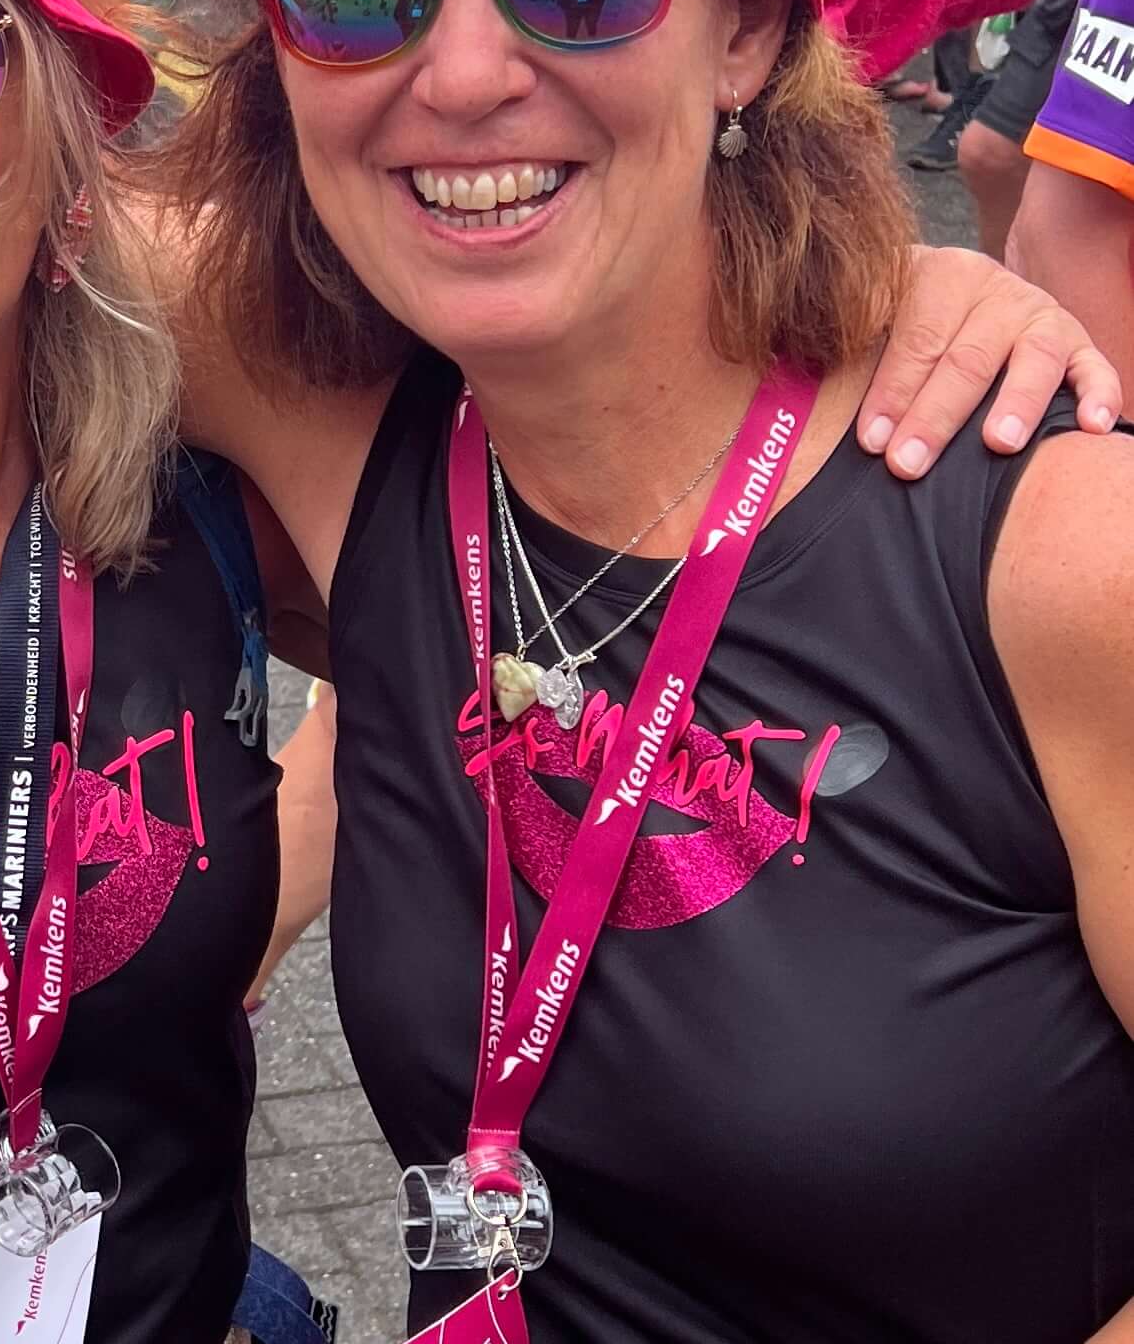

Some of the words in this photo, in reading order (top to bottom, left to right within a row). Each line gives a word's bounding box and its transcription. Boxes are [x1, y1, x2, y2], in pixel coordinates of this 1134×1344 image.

[1074, 23, 1134, 83] AAN
[29, 482, 43, 559] TOEWIJDING
[723, 408, 796, 537] Kemkens
[28, 572, 42, 624] KRACHT
[23, 636, 40, 749] VERBONDENHEID
[616, 673, 685, 807] Kemkens
[1, 769, 33, 910] MARINIERS
[38, 895, 67, 1013] Kemkens
[517, 938, 581, 1064] Kemkens
[23, 1248, 48, 1320] Kemken
